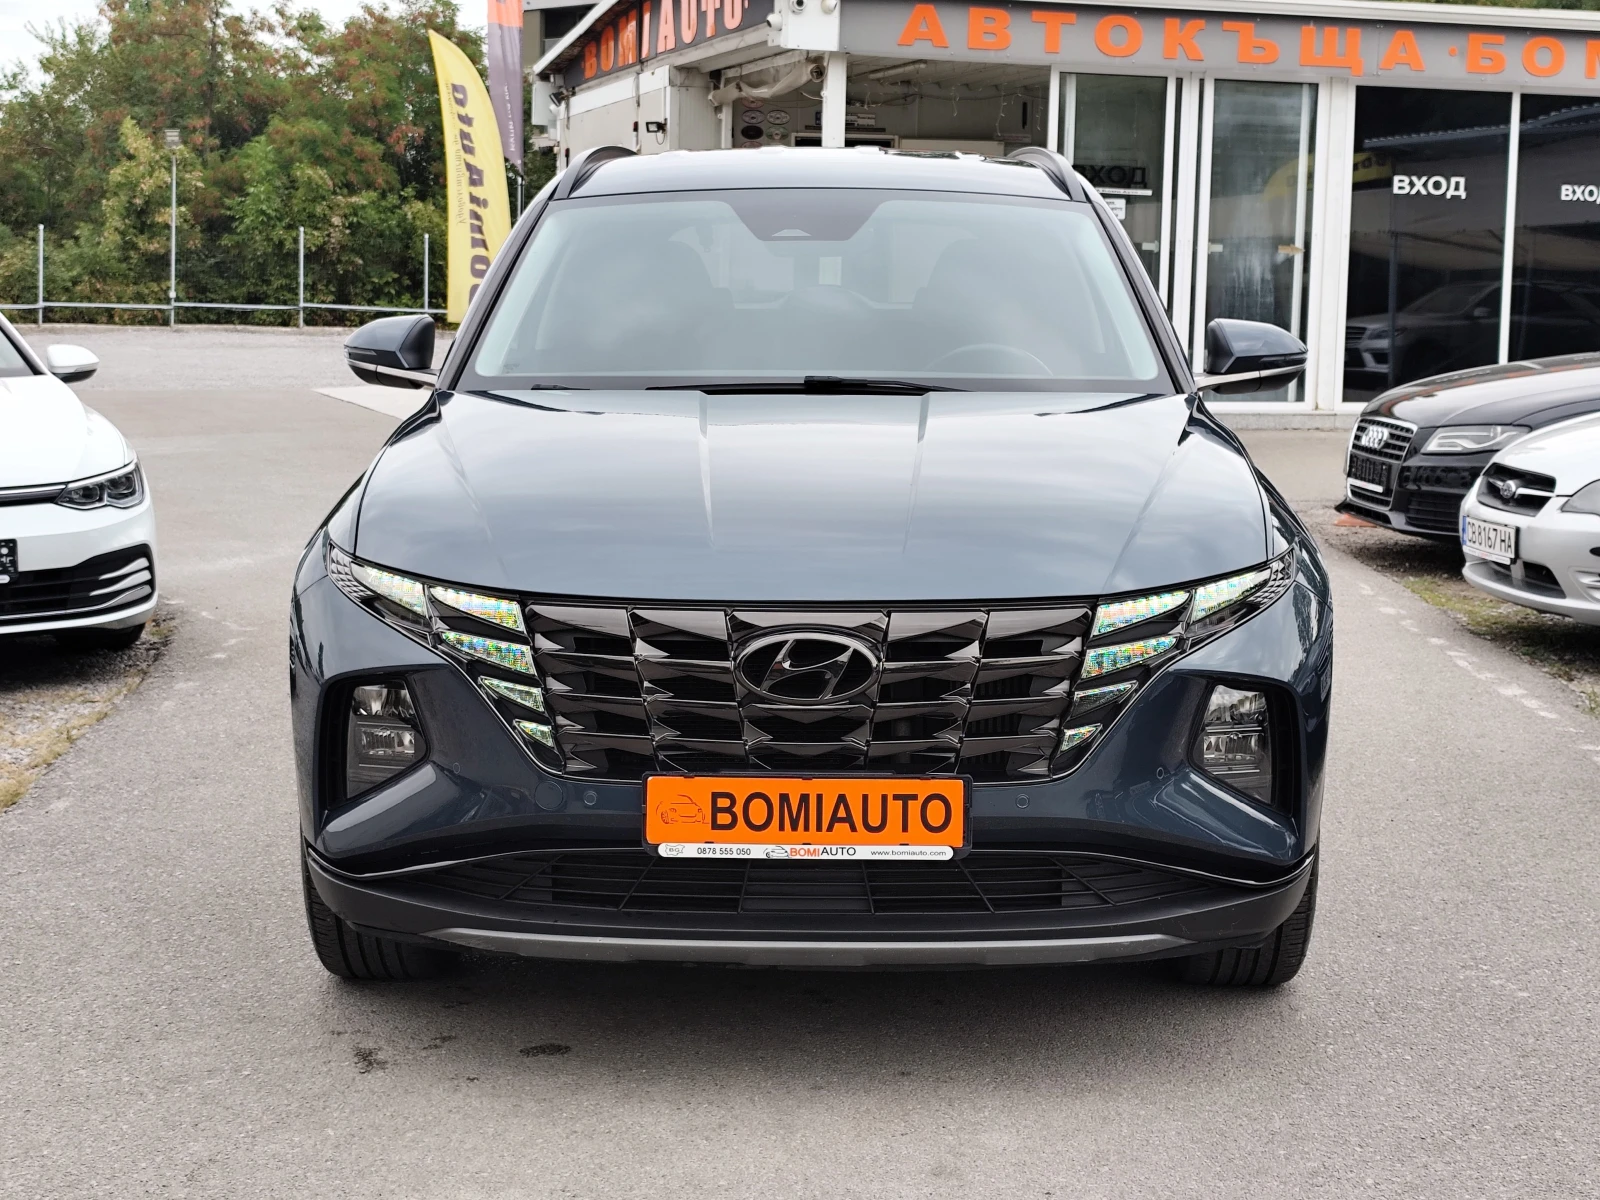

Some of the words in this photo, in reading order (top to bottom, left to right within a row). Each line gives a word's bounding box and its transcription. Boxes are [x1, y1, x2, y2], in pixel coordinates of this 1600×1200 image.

[897, 4, 1425, 77] АВТОКЪЩА
[1393, 175, 1467, 199] ВХОД
[1477, 524, 1498, 550] 8167
[710, 791, 952, 833] BOMIAUTO
[697, 847, 717, 855] 0878
[719, 847, 734, 856] 555
[736, 848, 752, 856] 050
[870, 849, 947, 857] www.bomiauto.com
